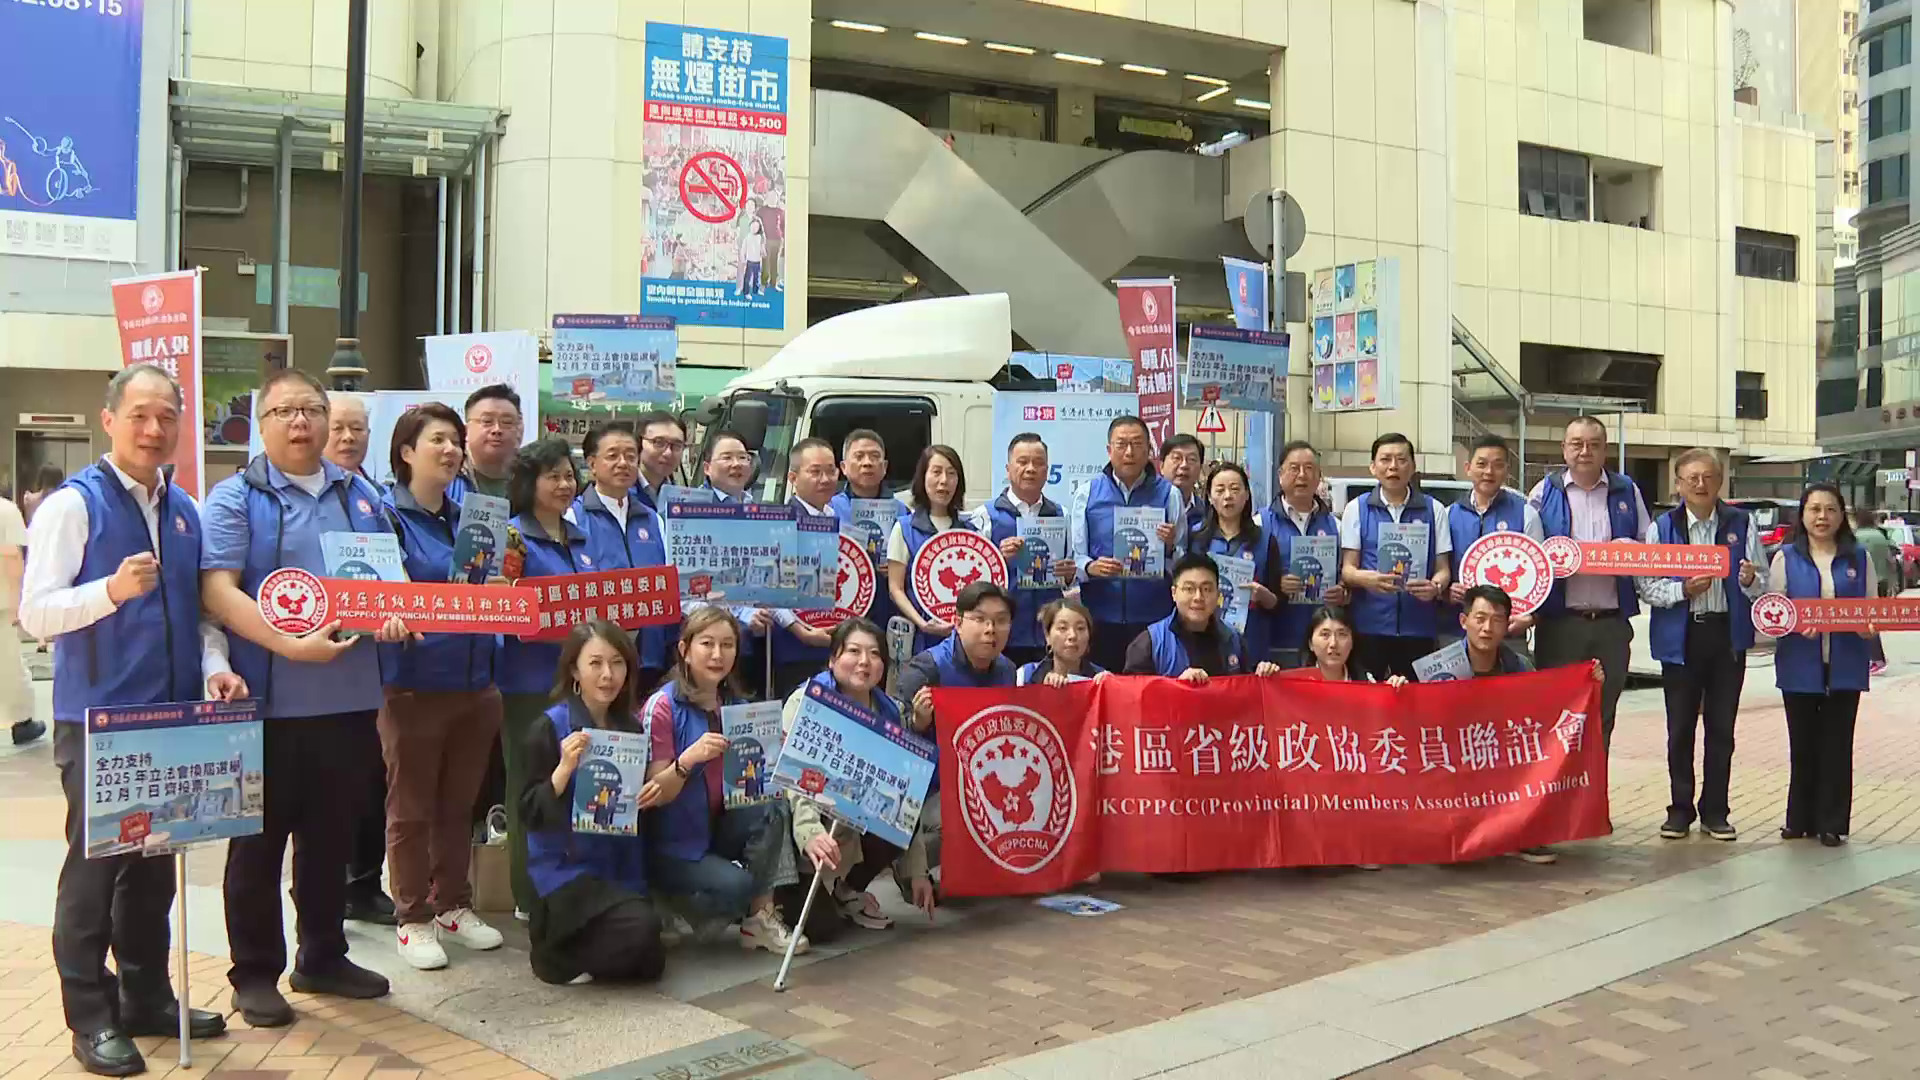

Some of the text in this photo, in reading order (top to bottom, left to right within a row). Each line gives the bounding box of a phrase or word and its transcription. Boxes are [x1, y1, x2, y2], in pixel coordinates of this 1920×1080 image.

[682, 32, 753, 65] 請支持
[651, 56, 779, 102] 無煙街市
[651, 89, 675, 100] Please
[677, 94, 705, 103] support
[713, 97, 753, 107] smoke-free
[755, 102, 781, 110] market
[740, 114, 782, 129] $1,500
[467, 509, 491, 521] 2025
[856, 510, 875, 519] 2025
[1118, 517, 1138, 526] 2025
[672, 535, 712, 545] 全力支持
[1382, 532, 1403, 541] 2025
[339, 546, 366, 558] 2025
[437, 613, 476, 622] MEMBERS
[478, 614, 531, 624] ASSOCIATION
[728, 722, 754, 736] 2025
[1090, 708, 1588, 775] 港區省級政協委員聯誼會
[587, 743, 614, 757] 2025
[96, 752, 152, 771] 全力支持
[1414, 789, 1520, 810] Association
[1526, 771, 1591, 798] Limited
